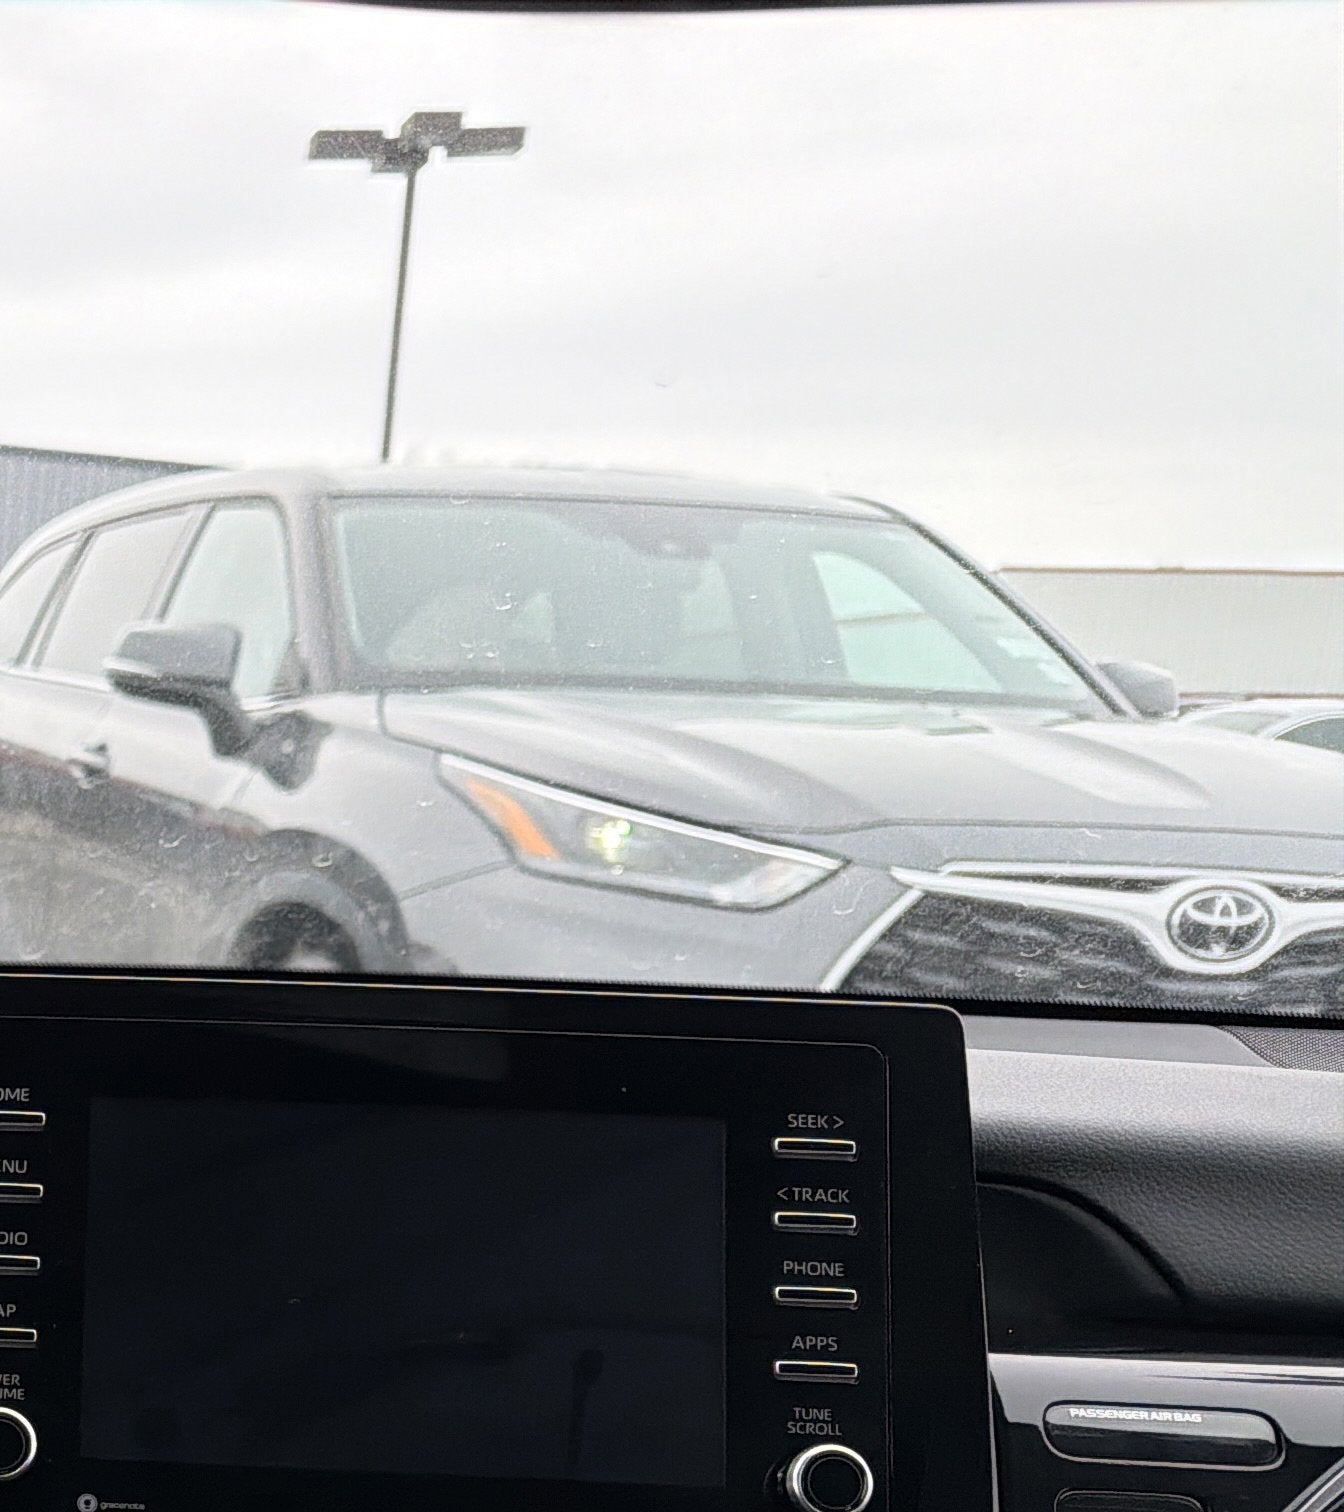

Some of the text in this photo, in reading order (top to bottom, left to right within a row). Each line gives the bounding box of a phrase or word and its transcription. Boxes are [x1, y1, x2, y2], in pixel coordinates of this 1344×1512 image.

[786, 1113, 829, 1129] SEEK
[792, 1186, 850, 1204] TRACK
[782, 1259, 846, 1277] PHONE
[791, 1334, 840, 1351] APPS
[792, 1406, 833, 1421] TUNE
[1068, 1407, 1203, 1423] PASSENGER AIR BAG
[786, 1421, 843, 1436] SCROLL
